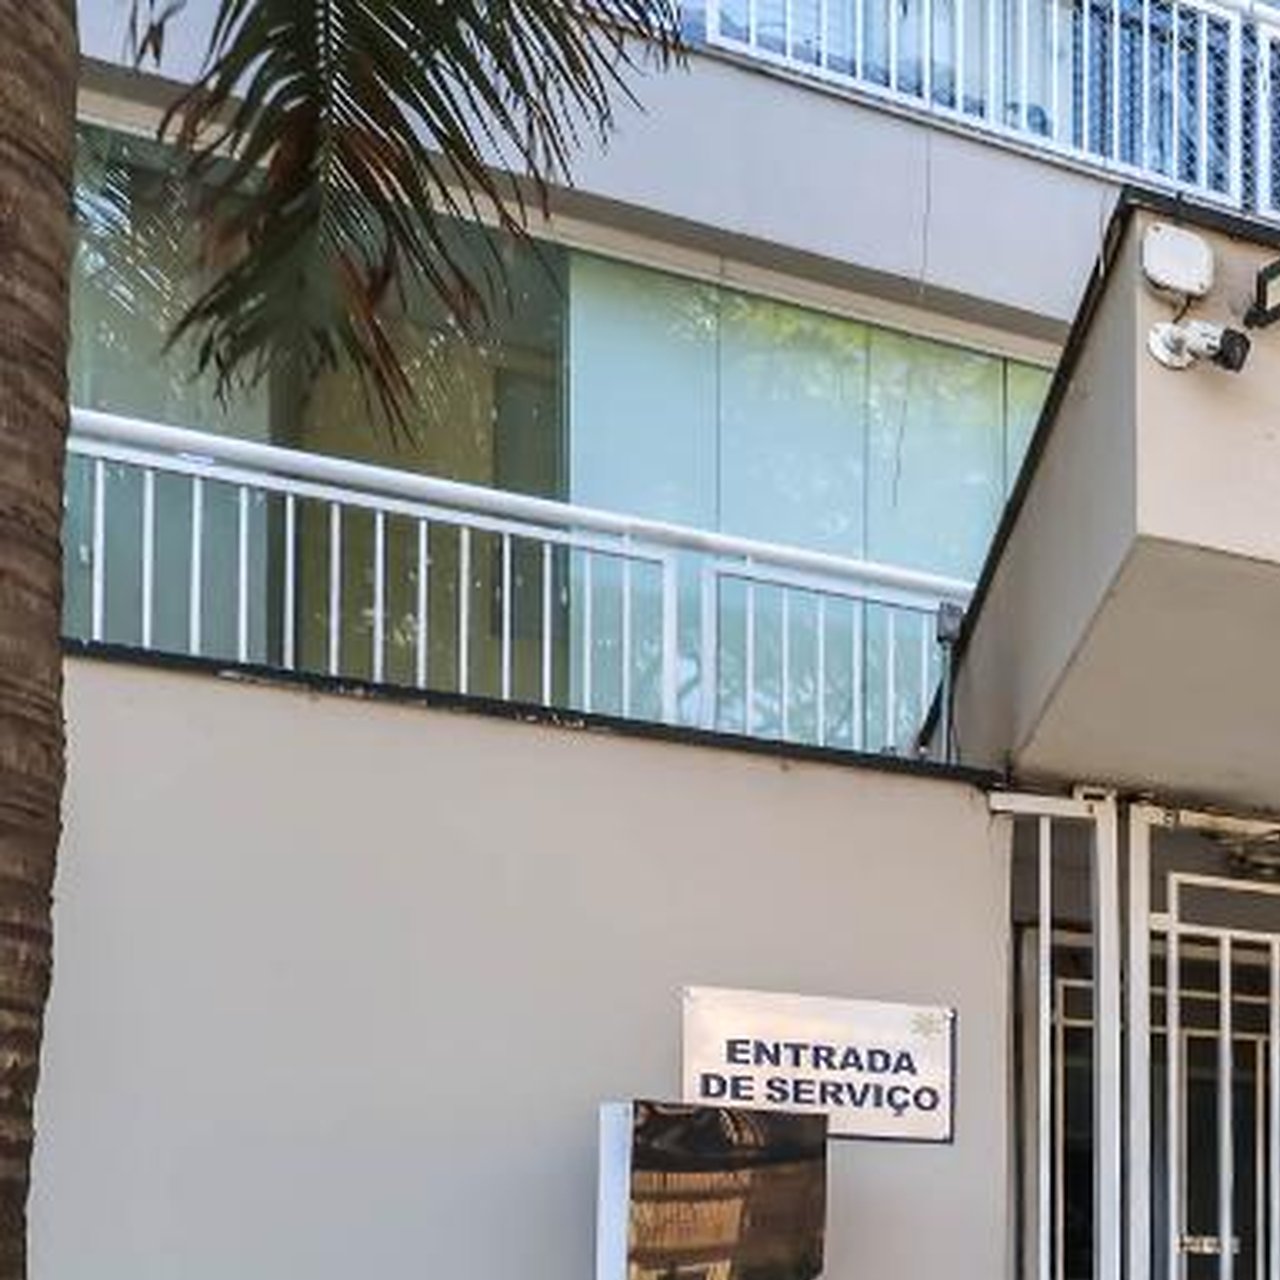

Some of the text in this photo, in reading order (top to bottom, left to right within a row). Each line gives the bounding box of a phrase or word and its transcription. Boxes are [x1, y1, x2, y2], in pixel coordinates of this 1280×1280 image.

[725, 1038, 918, 1077] ENTRADA
[700, 1073, 941, 1117] DE SERVIÇO
